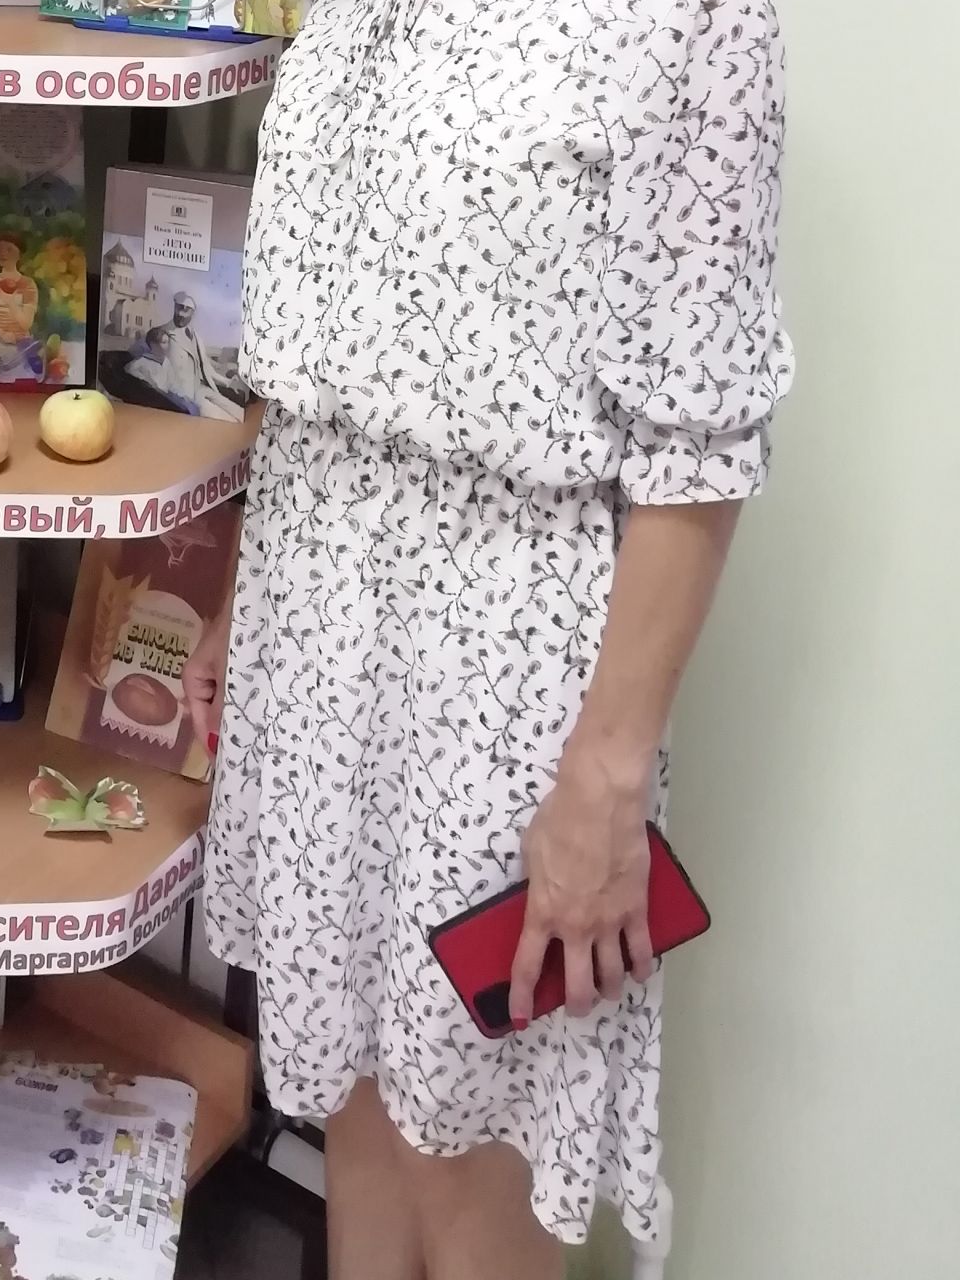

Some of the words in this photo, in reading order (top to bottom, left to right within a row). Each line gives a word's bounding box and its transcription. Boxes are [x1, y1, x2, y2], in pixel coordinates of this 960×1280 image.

[35, 61, 202, 102] особые
[207, 53, 275, 96] поры:
[148, 246, 207, 265] ГОСПОДНЕ
[162, 237, 192, 251] ЛЕТО
[119, 447, 251, 534] Медовый
[112, 640, 135, 665] ИЗ
[139, 646, 184, 680] ХЛЕБ
[127, 624, 190, 659] БЛЮДА
